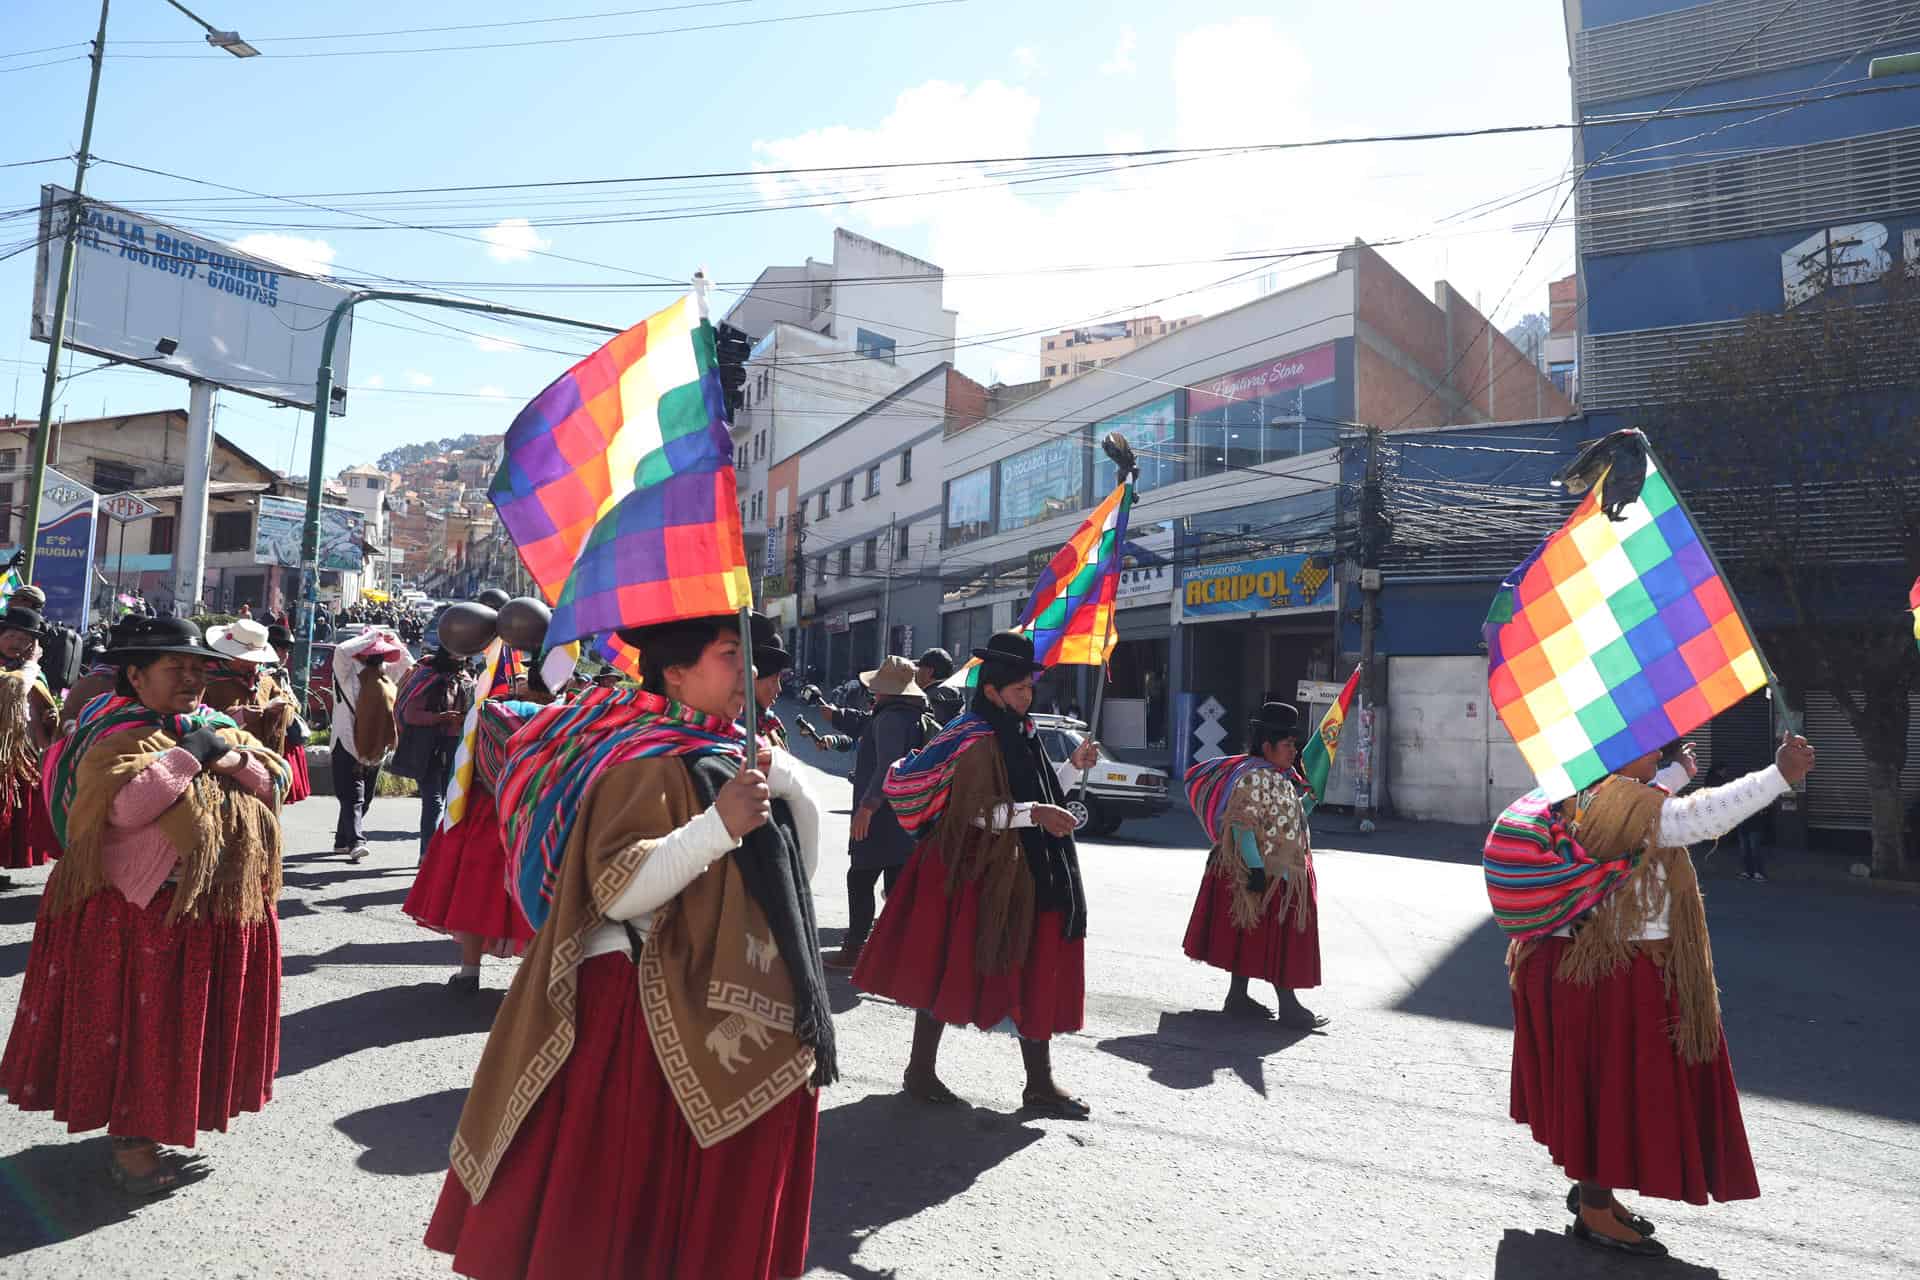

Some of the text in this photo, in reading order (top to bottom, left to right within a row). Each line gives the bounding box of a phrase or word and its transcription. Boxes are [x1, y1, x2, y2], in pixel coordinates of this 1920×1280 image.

[82, 208, 280, 292] ALLA DISPONIBLE
[1268, 361, 1305, 382] Store
[106, 496, 144, 516] YPFB
[1185, 570, 1291, 607] ACRIPOL
